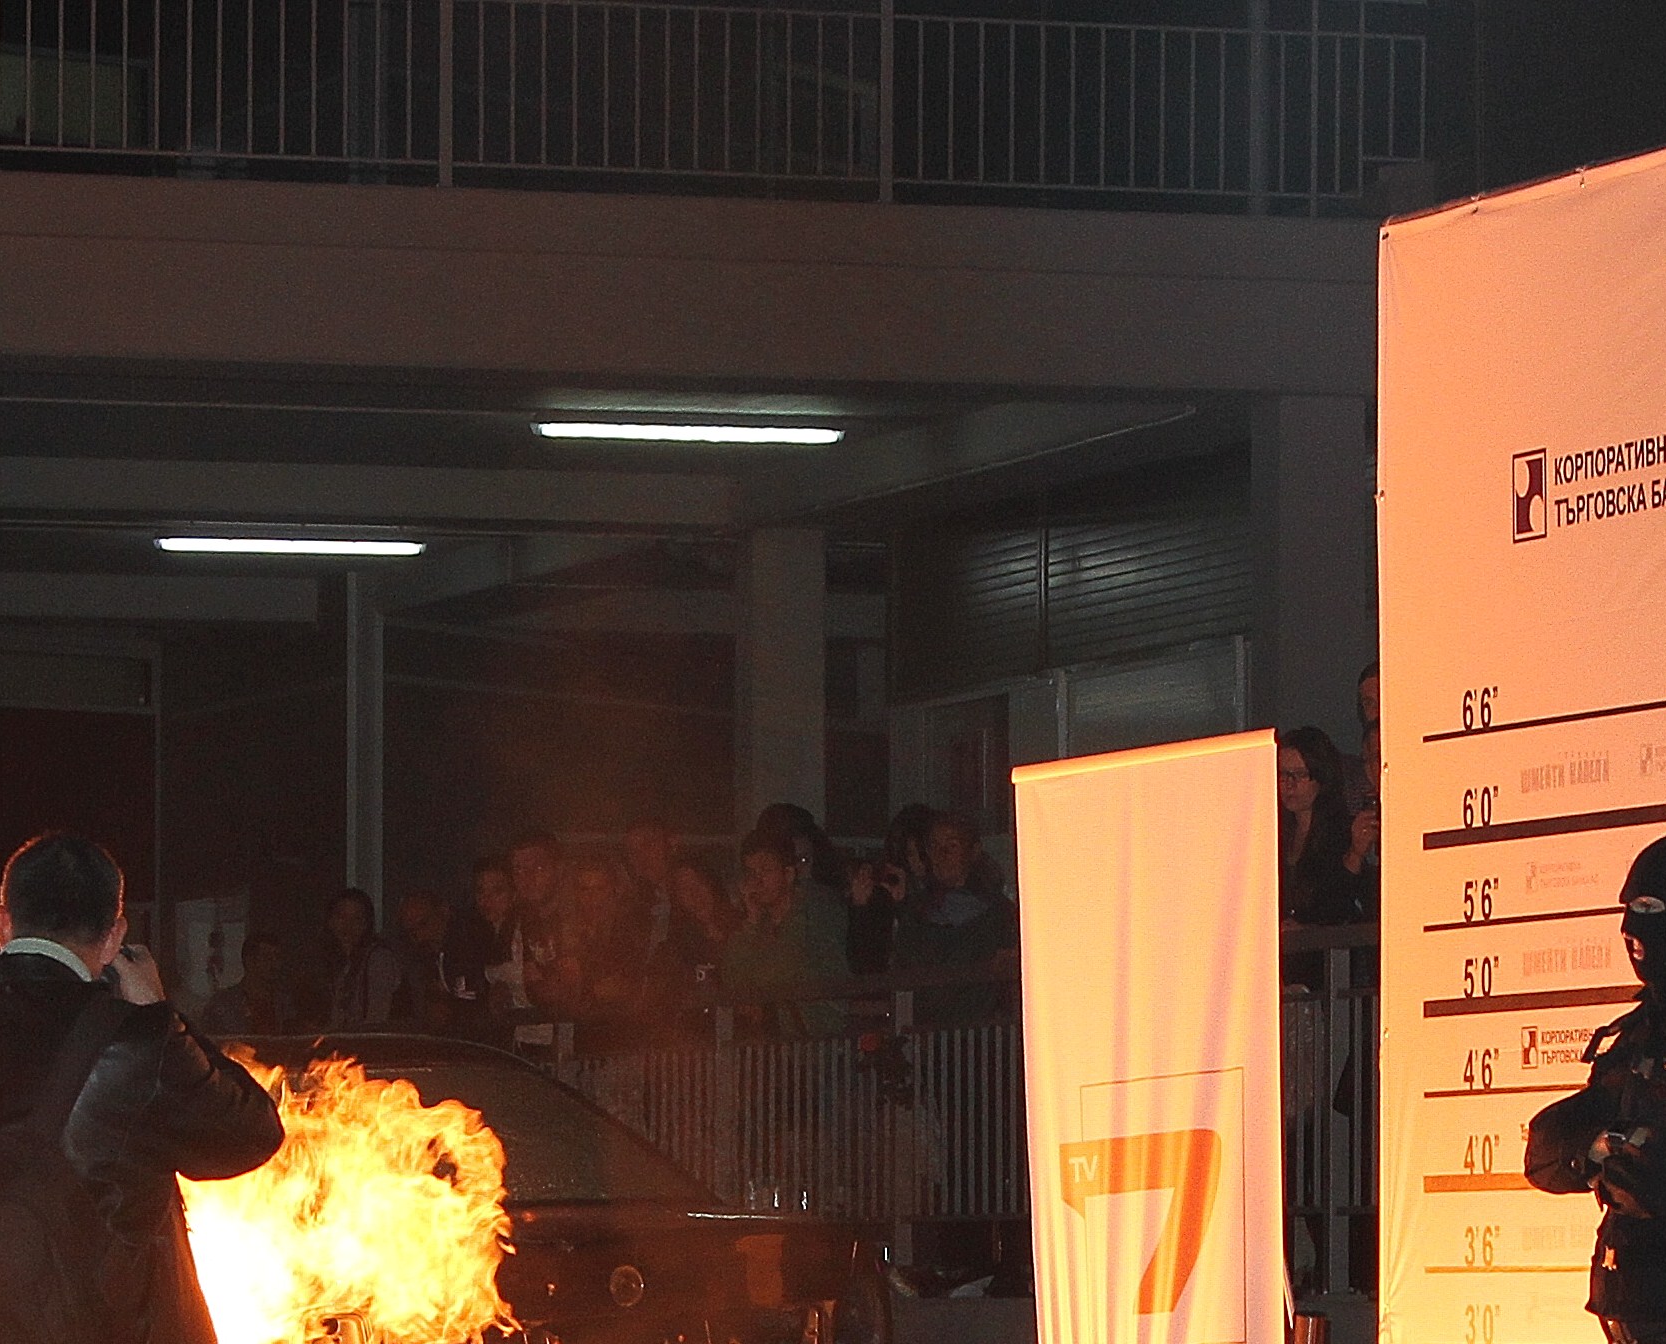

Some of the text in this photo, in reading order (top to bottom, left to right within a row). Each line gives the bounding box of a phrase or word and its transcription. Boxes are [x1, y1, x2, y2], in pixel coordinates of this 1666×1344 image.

[1555, 483, 1647, 527] ТЪРГОВСКА
[1542, 1029, 1595, 1044] КОРПОРАТИВН
[1069, 1155, 1098, 1183] TV
